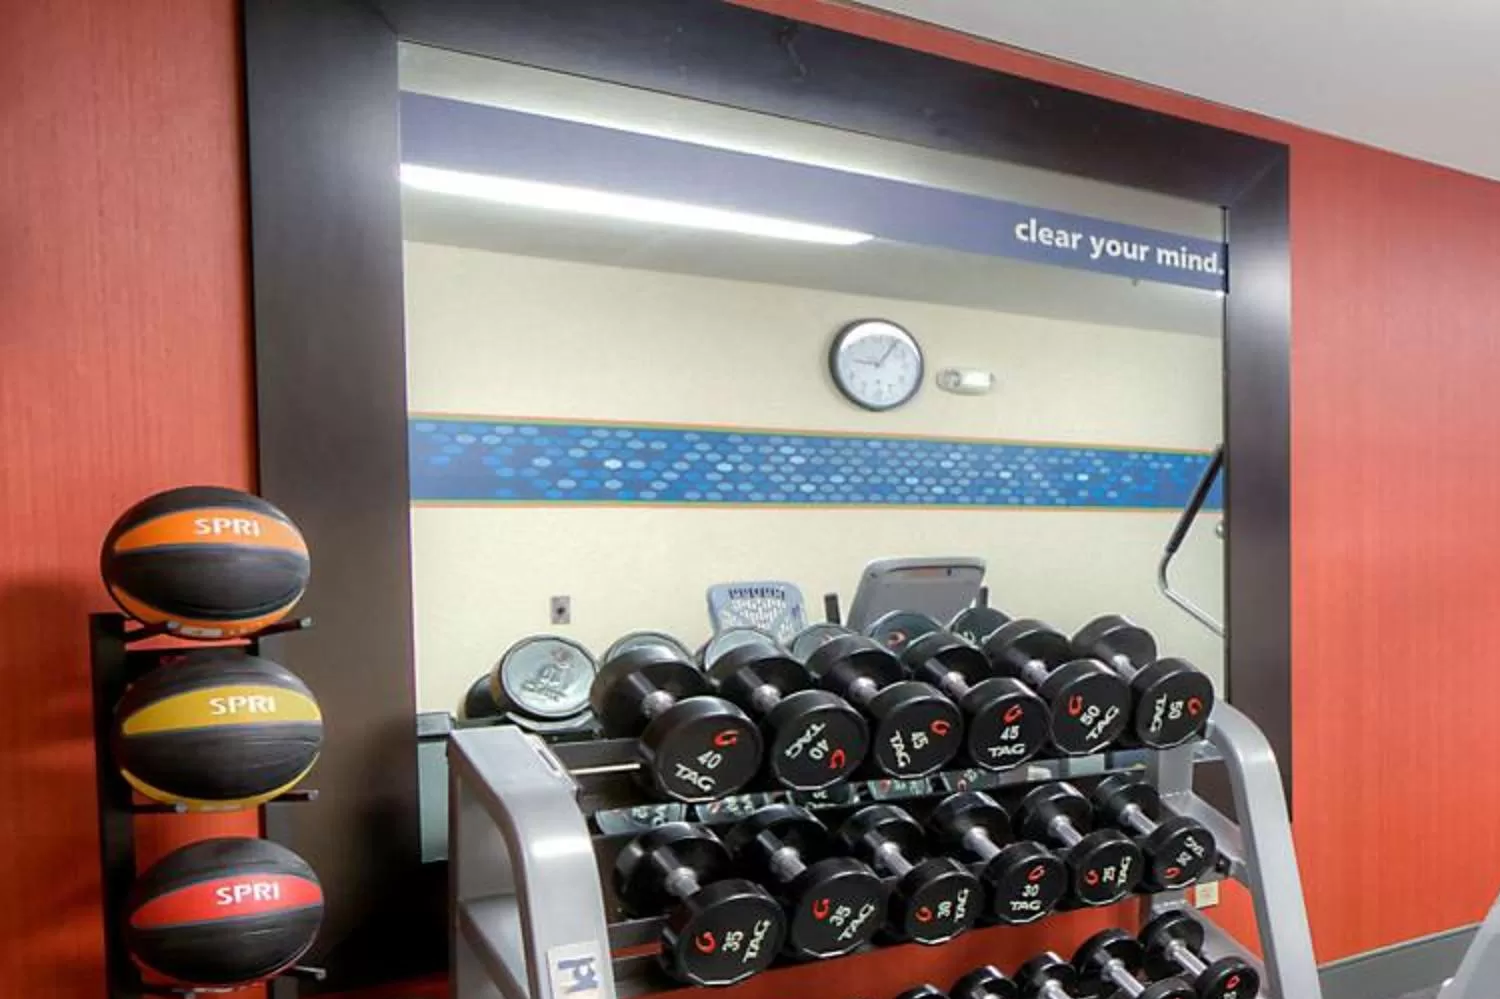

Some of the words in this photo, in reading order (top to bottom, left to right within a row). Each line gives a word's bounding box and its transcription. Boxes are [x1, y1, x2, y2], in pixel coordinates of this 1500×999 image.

[1014, 218, 1083, 249] clear
[1090, 235, 1150, 261] your
[1156, 247, 1225, 275] mind.
[193, 517, 260, 537] SPRI
[209, 695, 277, 716] SPRI
[1080, 705, 1101, 726] 50
[1150, 693, 1167, 733] TAG
[1168, 701, 1185, 719] 50
[1000, 725, 1020, 741] 45
[1085, 705, 1120, 741] TAG
[785, 722, 827, 758] TAG
[809, 739, 829, 760] 40
[889, 729, 911, 769] TAG
[911, 731, 929, 749] 45
[987, 743, 1025, 757] TAG
[697, 750, 722, 769] 40
[675, 763, 716, 793] TAG
[1116, 856, 1132, 887] TAG
[215, 881, 281, 905] SPRI
[1021, 884, 1040, 898] 30
[829, 905, 851, 927] 35
[953, 888, 969, 923] TAG
[1009, 900, 1042, 912] TAG
[837, 903, 875, 942] TAG
[722, 931, 744, 952] 35
[742, 919, 771, 964] TAG
